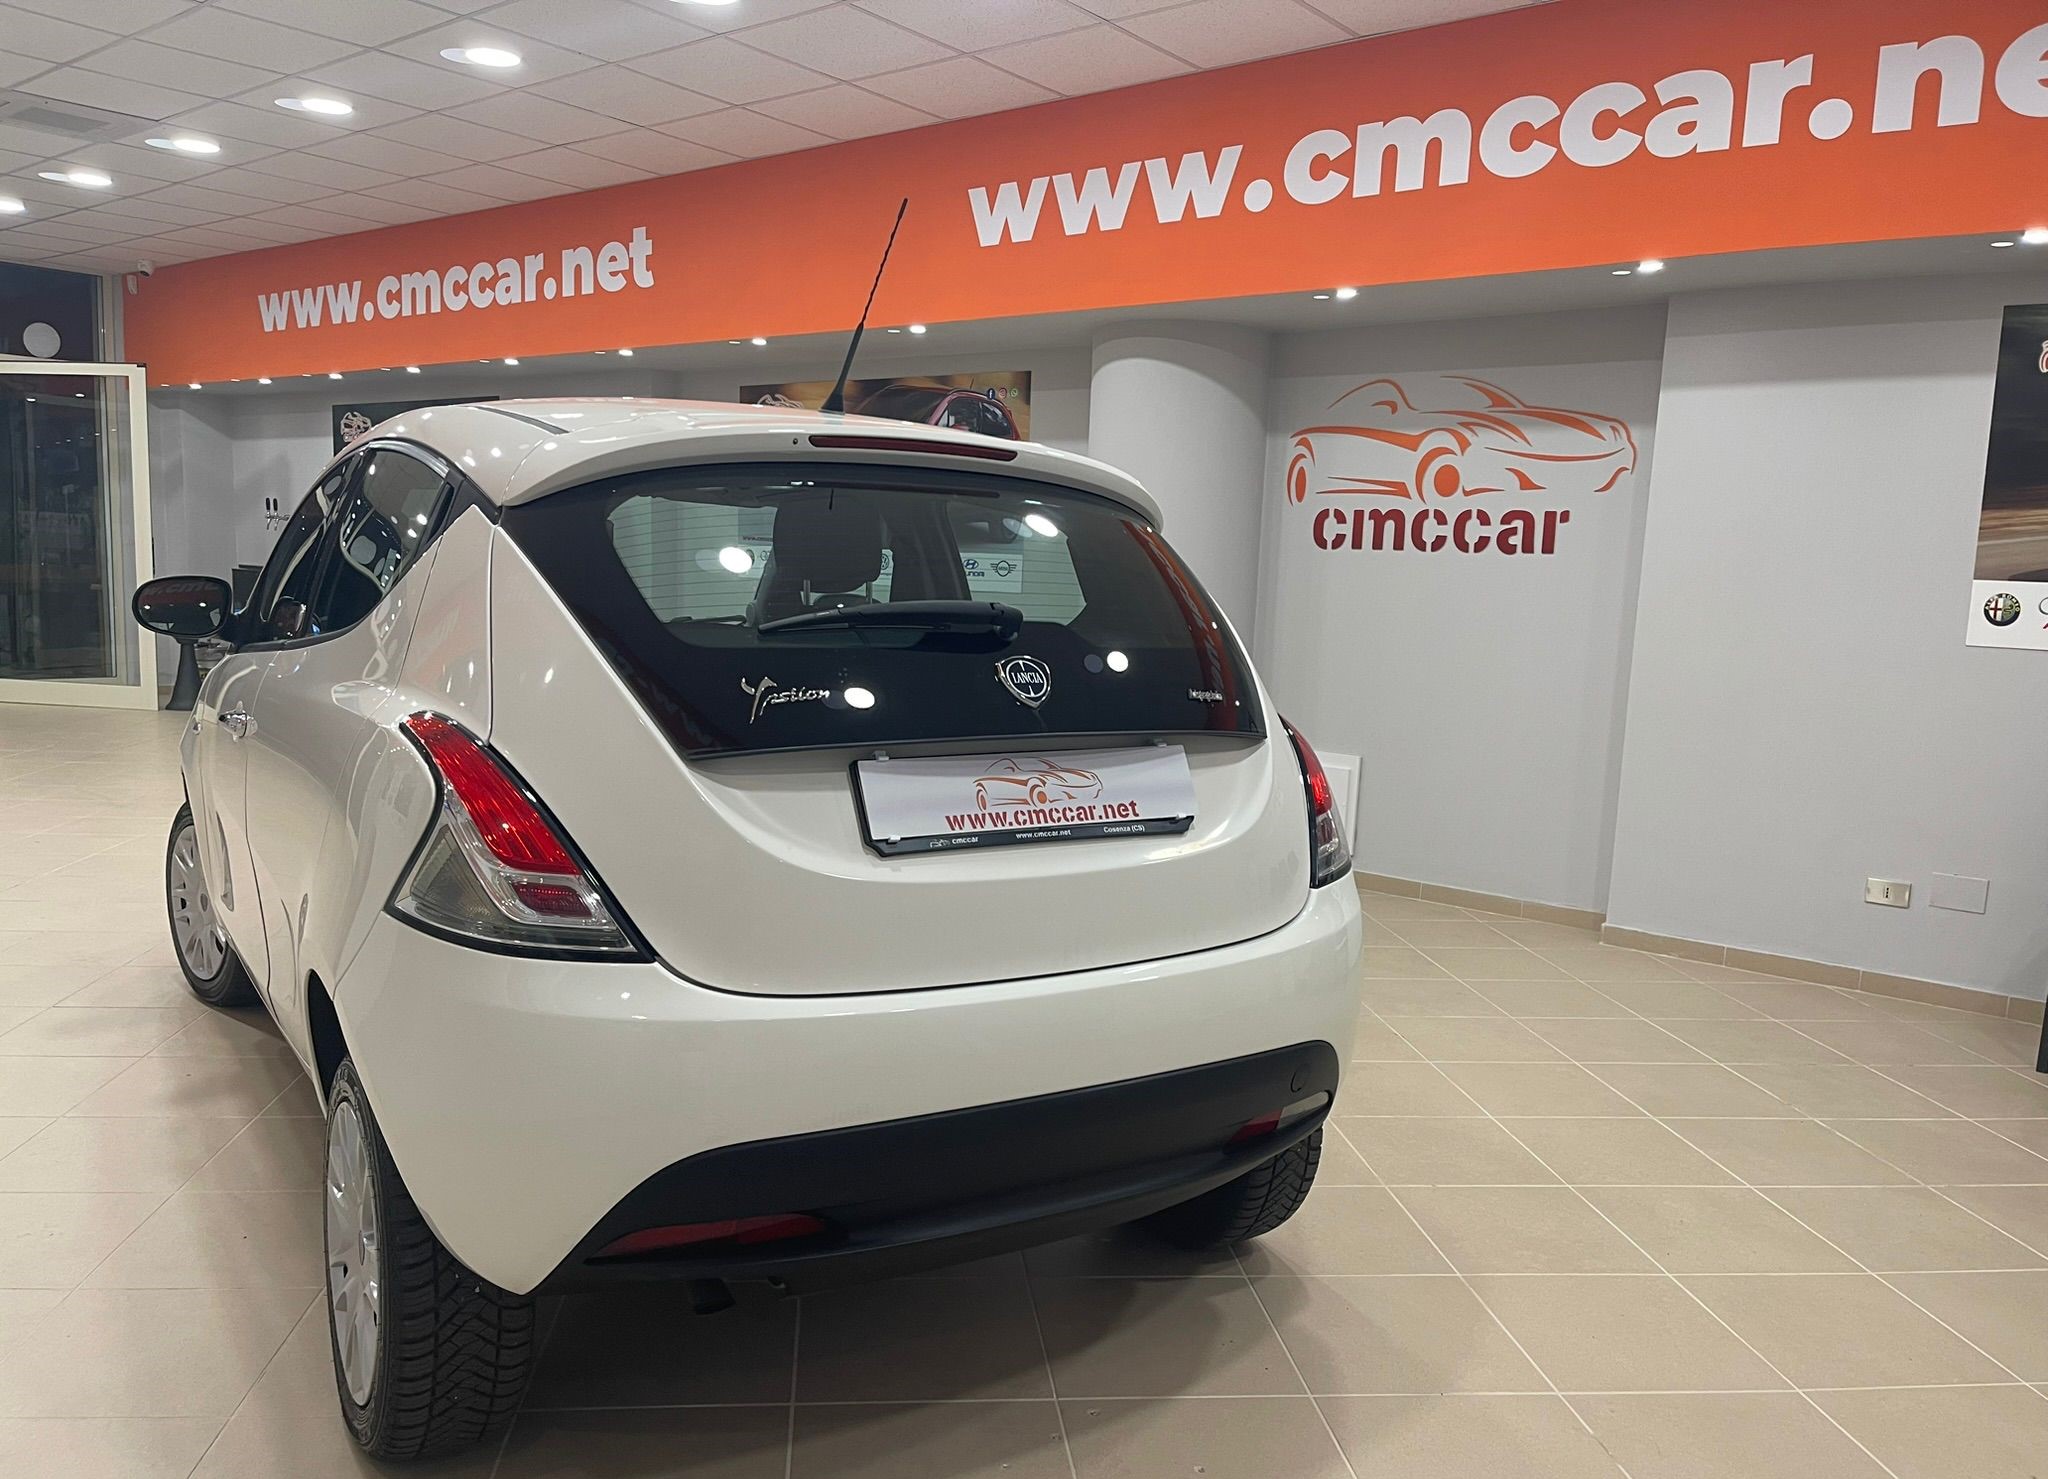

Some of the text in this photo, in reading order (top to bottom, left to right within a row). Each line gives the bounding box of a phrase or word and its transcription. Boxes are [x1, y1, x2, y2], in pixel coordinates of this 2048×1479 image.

[258, 227, 654, 331] www.cmccar.net
[1313, 508, 1570, 556] cmccar
[1010, 672, 1044, 684] LANCIA
[740, 676, 831, 724] Ypsilon
[945, 800, 1139, 831] www.cmccar.net
[1015, 829, 1071, 839] www.cmccar.net
[1103, 824, 1146, 833] Cosenza (CS)
[951, 836, 979, 844] cmccar
